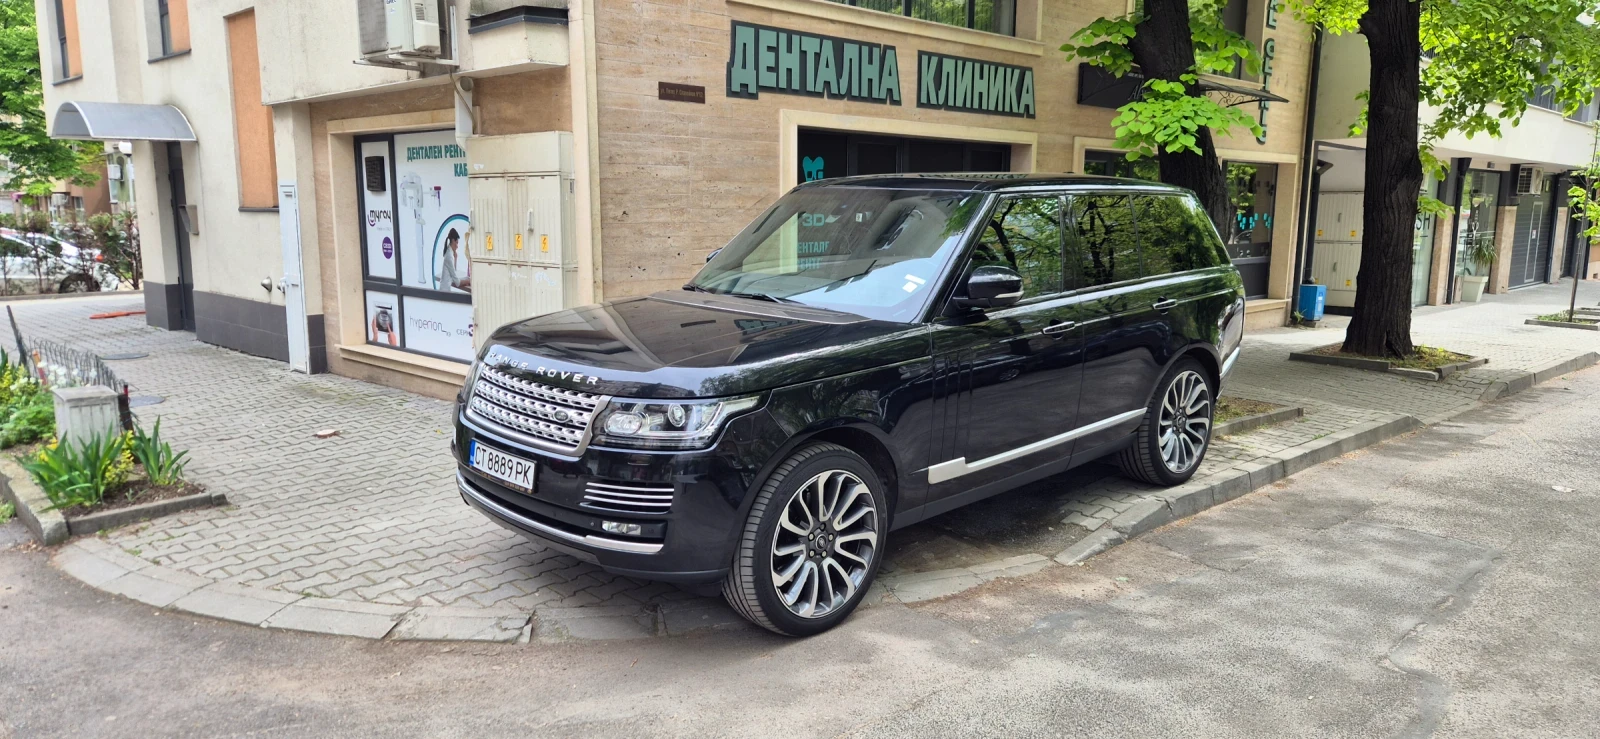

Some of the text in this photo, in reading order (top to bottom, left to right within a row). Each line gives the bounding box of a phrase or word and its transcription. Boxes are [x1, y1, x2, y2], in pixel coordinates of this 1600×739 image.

[730, 24, 1035, 116] ДЕНТАЛНА КЛИНИКА
[407, 145, 443, 162] ДЕНТАЛЕН
[802, 213, 825, 227] 3D
[489, 352, 599, 385] RANGE ROVER
